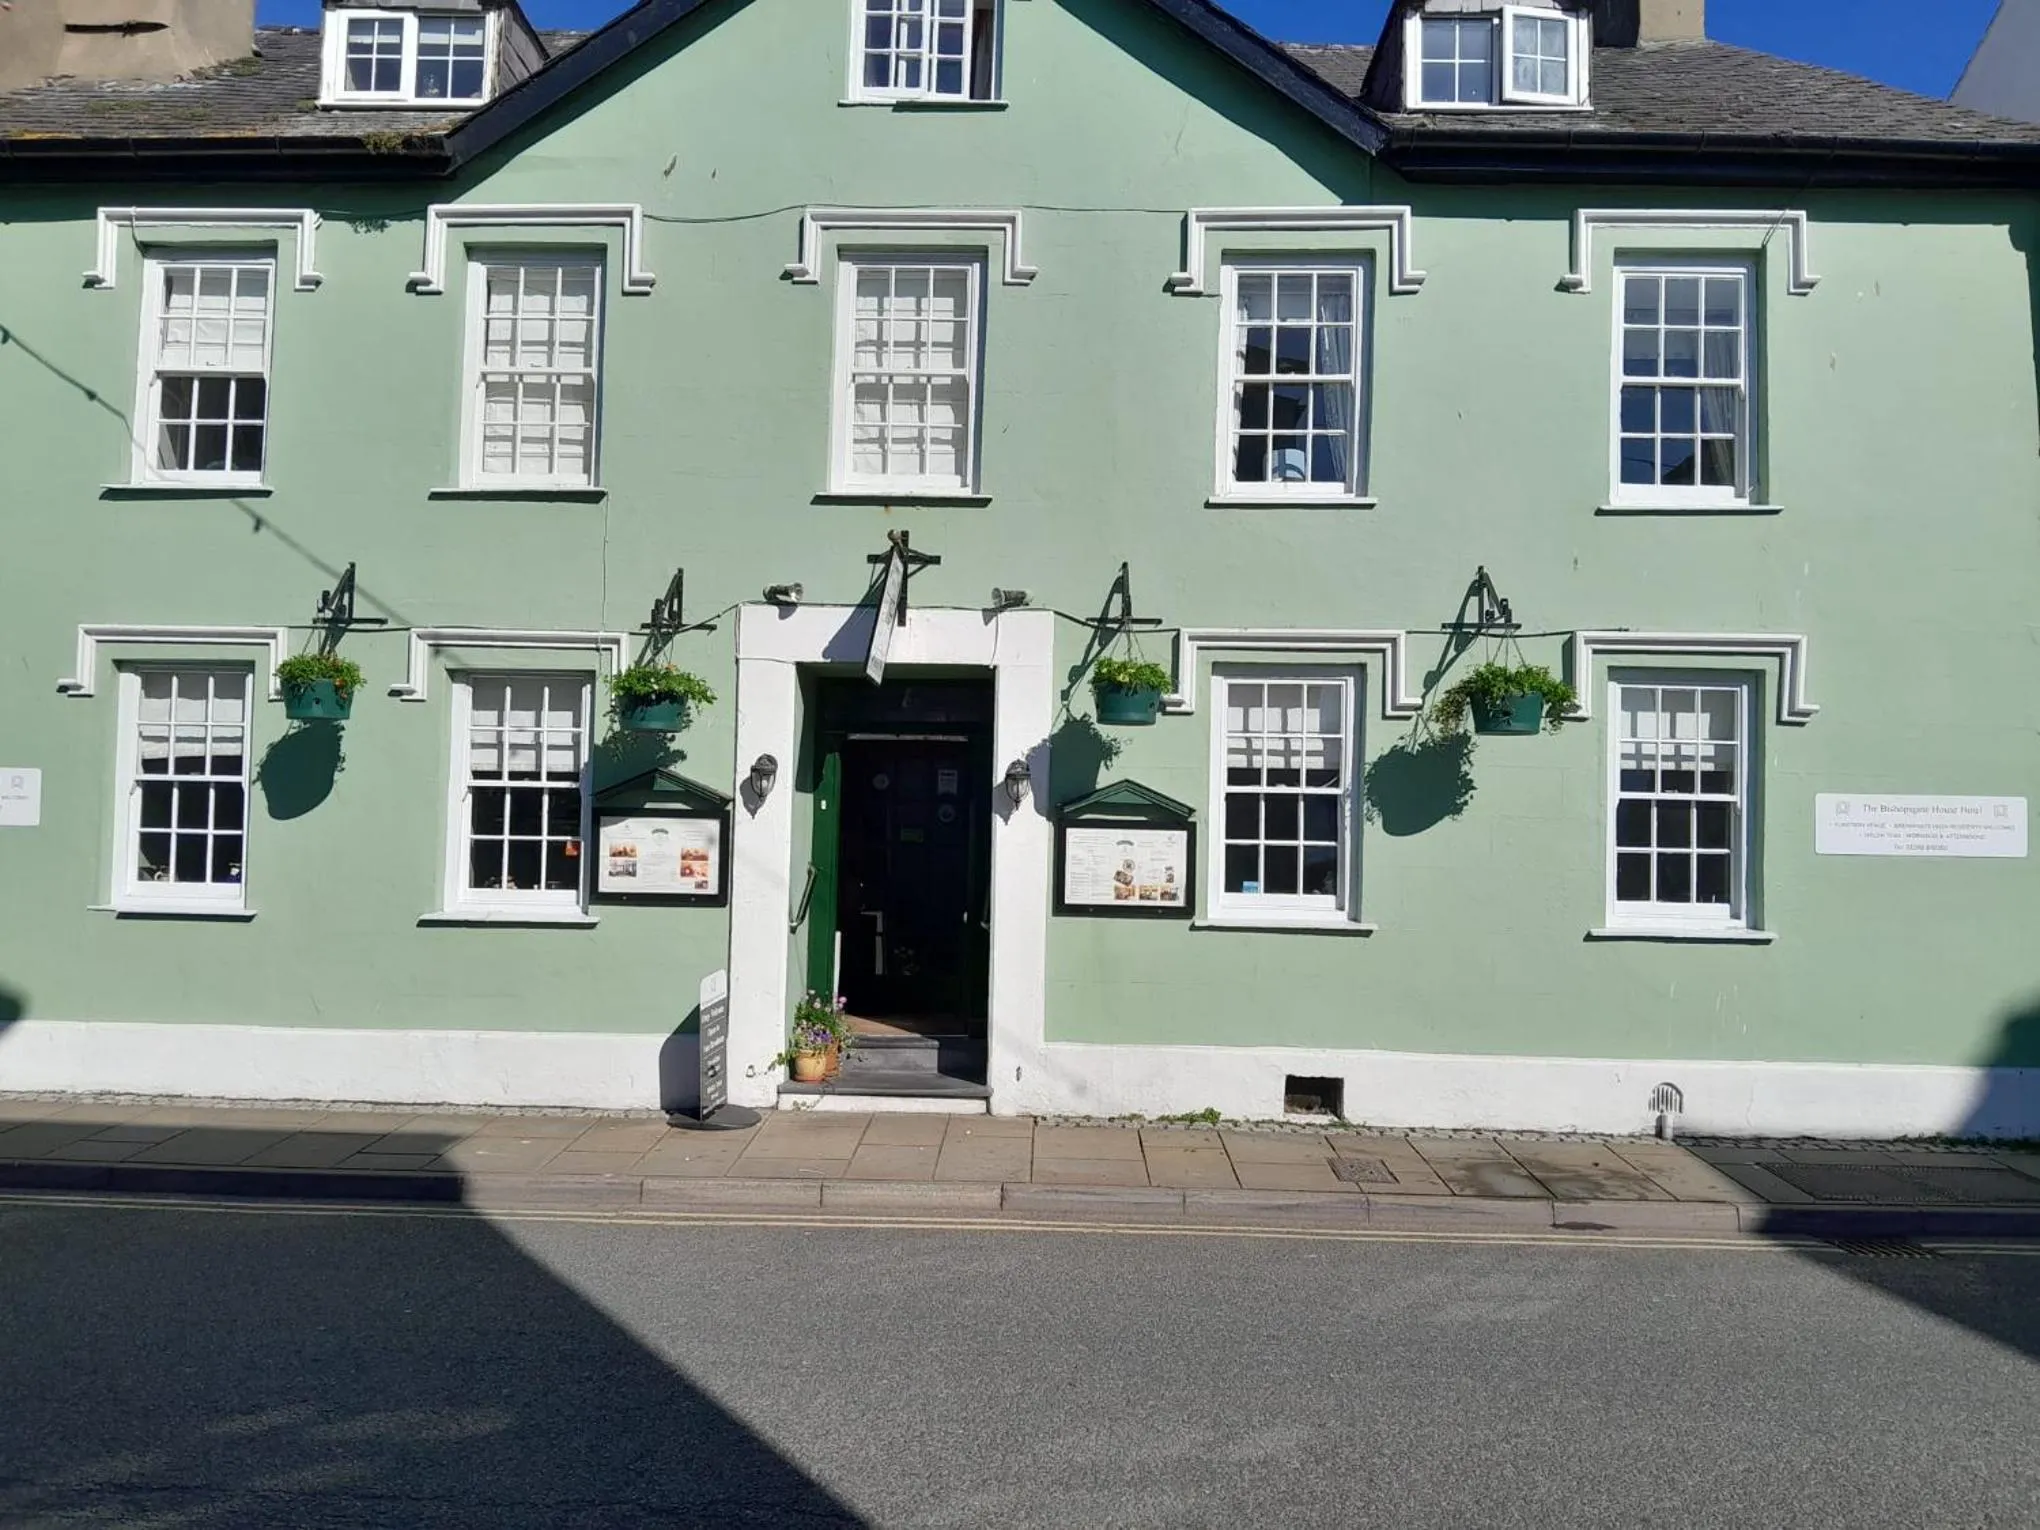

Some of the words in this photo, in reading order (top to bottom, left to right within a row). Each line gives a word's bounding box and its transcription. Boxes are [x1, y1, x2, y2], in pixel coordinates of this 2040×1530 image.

[1863, 804, 1878, 813] The
[1931, 805, 1958, 814] House
[1960, 805, 1983, 815] Hotel
